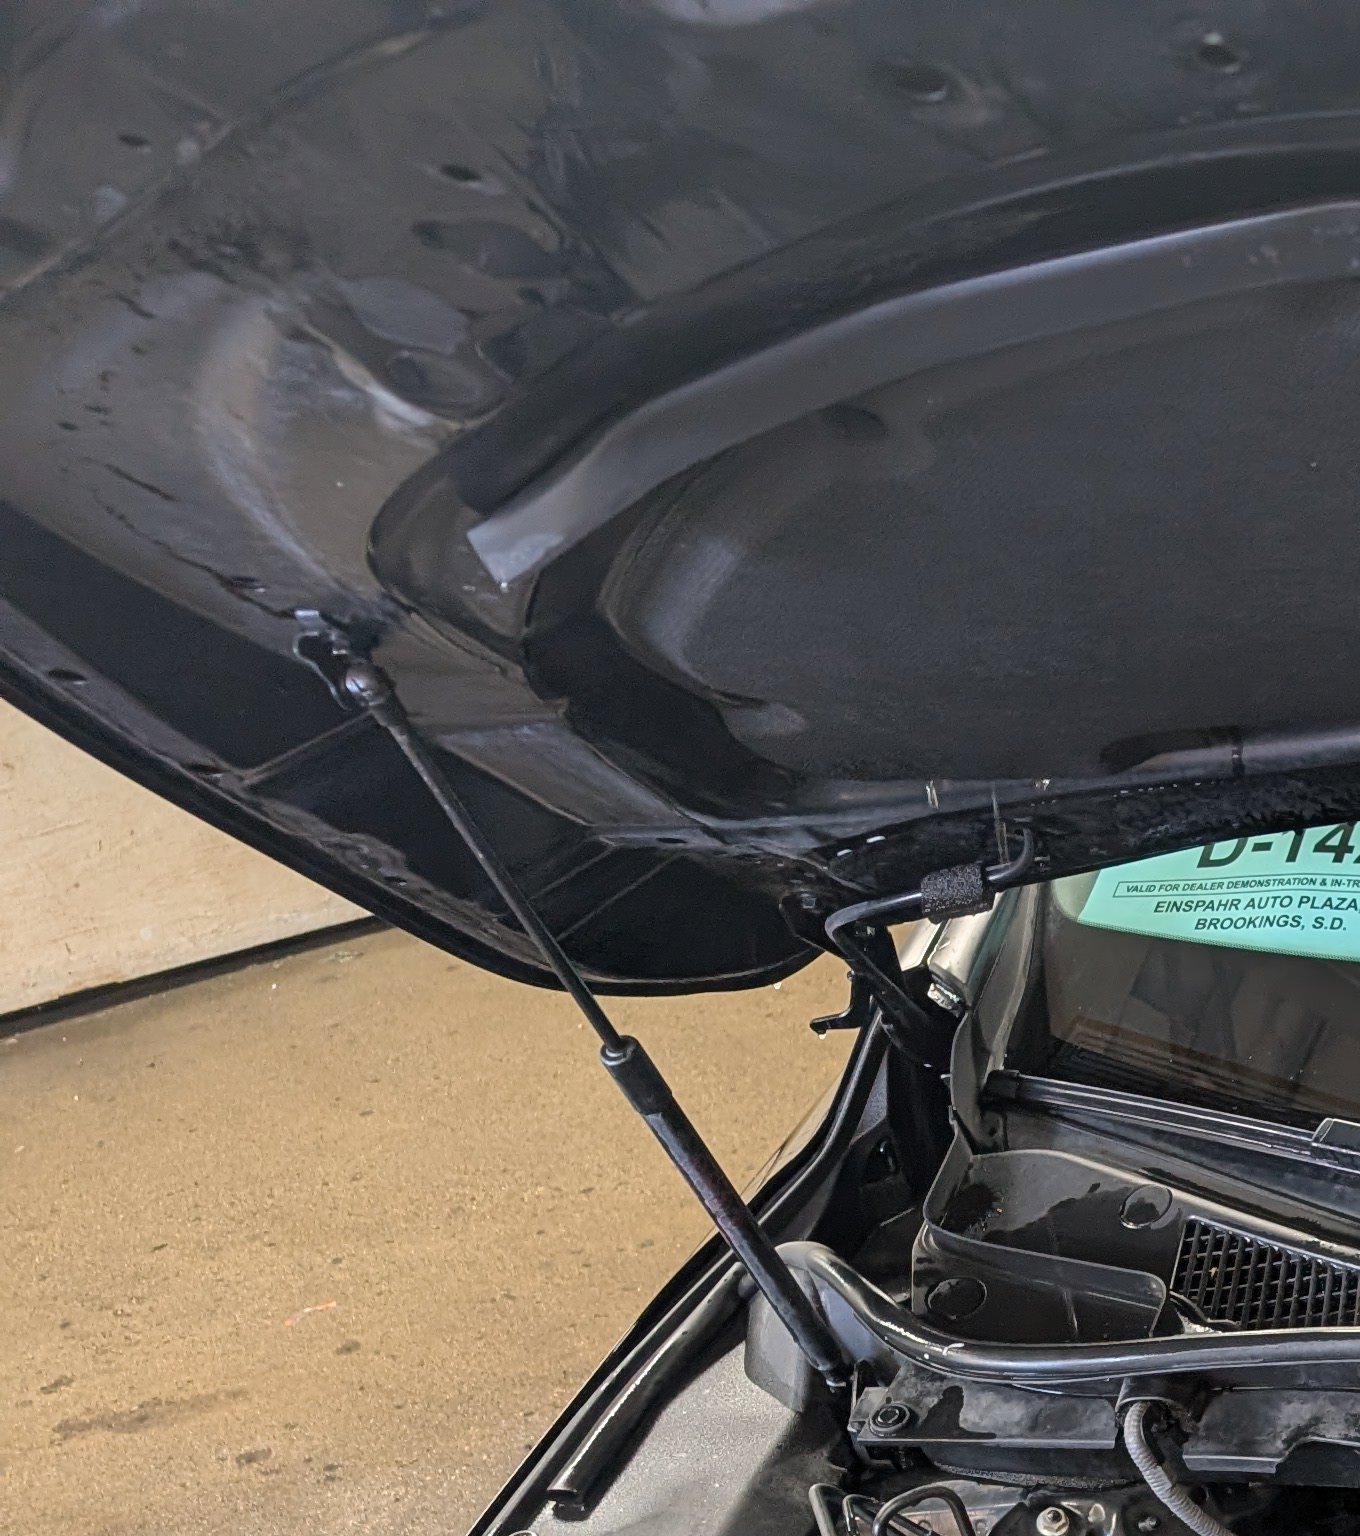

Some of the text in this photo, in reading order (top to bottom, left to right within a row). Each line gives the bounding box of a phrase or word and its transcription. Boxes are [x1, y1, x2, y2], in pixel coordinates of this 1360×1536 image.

[1126, 884, 1157, 893] VALID
[1158, 883, 1181, 893] FOR
[1182, 881, 1225, 891] DEALER
[1226, 877, 1318, 889] DEMONSTRATION
[1319, 878, 1328, 887] &
[1153, 898, 1242, 913] EINSPAHR
[1243, 895, 1293, 911] AUTO
[1194, 914, 1347, 931] BROOKINGS, S.D.
